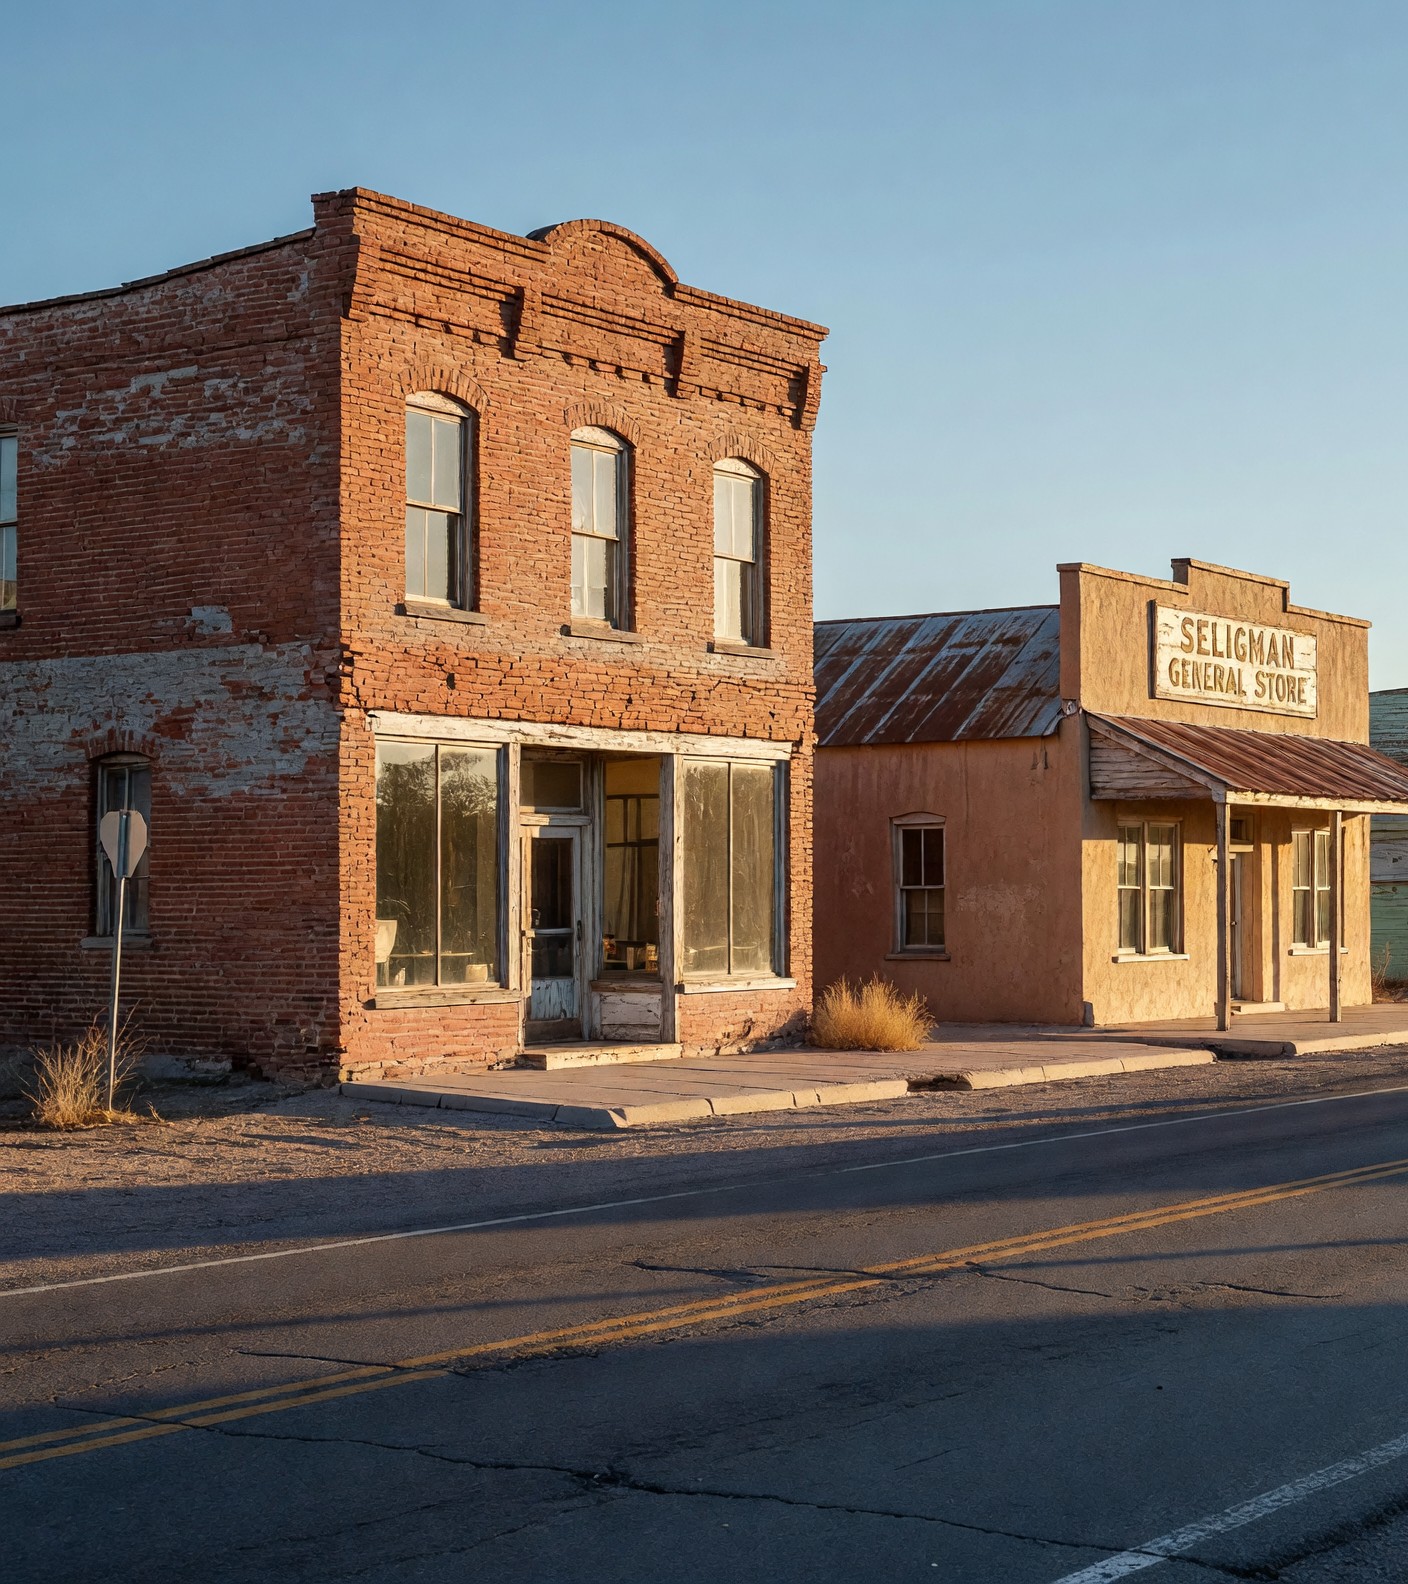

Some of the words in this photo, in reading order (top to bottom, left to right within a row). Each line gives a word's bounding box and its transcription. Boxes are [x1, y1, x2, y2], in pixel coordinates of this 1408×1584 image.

[1180, 616, 1295, 670] SELIGMAN
[1168, 657, 1247, 697] GENERAL
[1254, 670, 1307, 704] STORE
